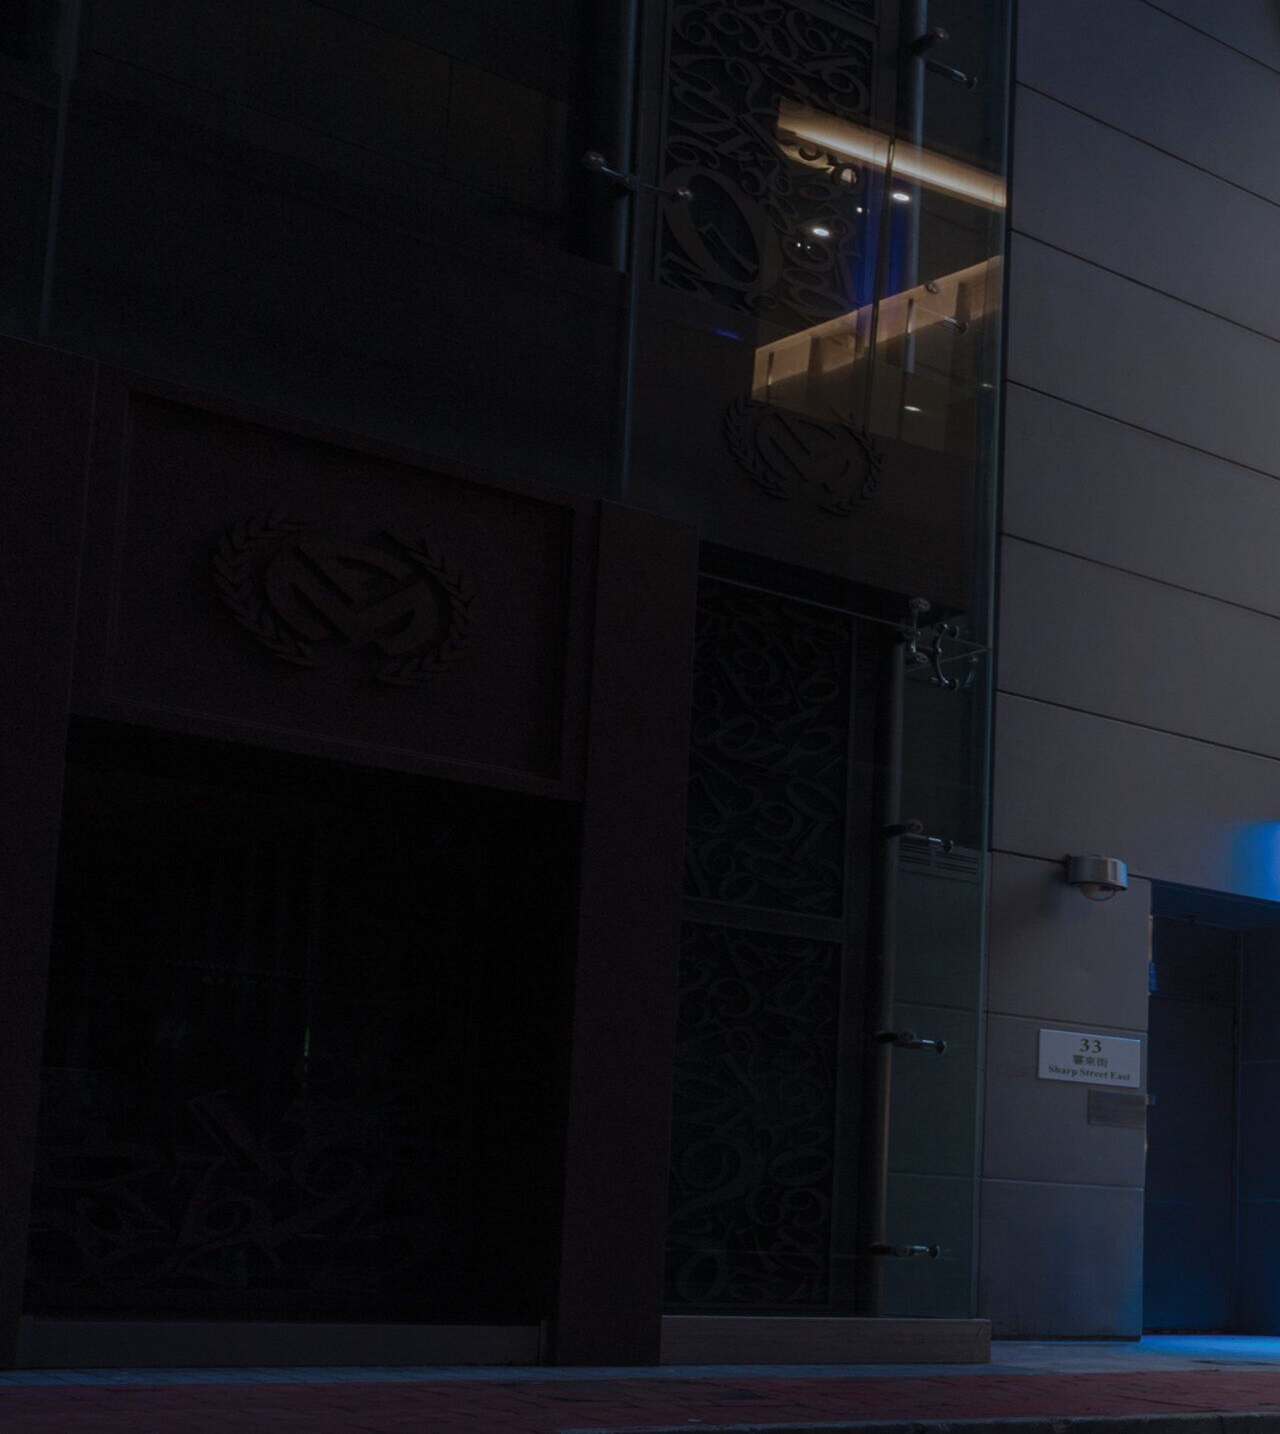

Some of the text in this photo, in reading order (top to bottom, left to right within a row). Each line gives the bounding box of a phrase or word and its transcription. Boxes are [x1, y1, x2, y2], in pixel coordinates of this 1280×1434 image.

[1080, 1038, 1102, 1053] 33
[1048, 1065, 1131, 1080] Sharp Street East
